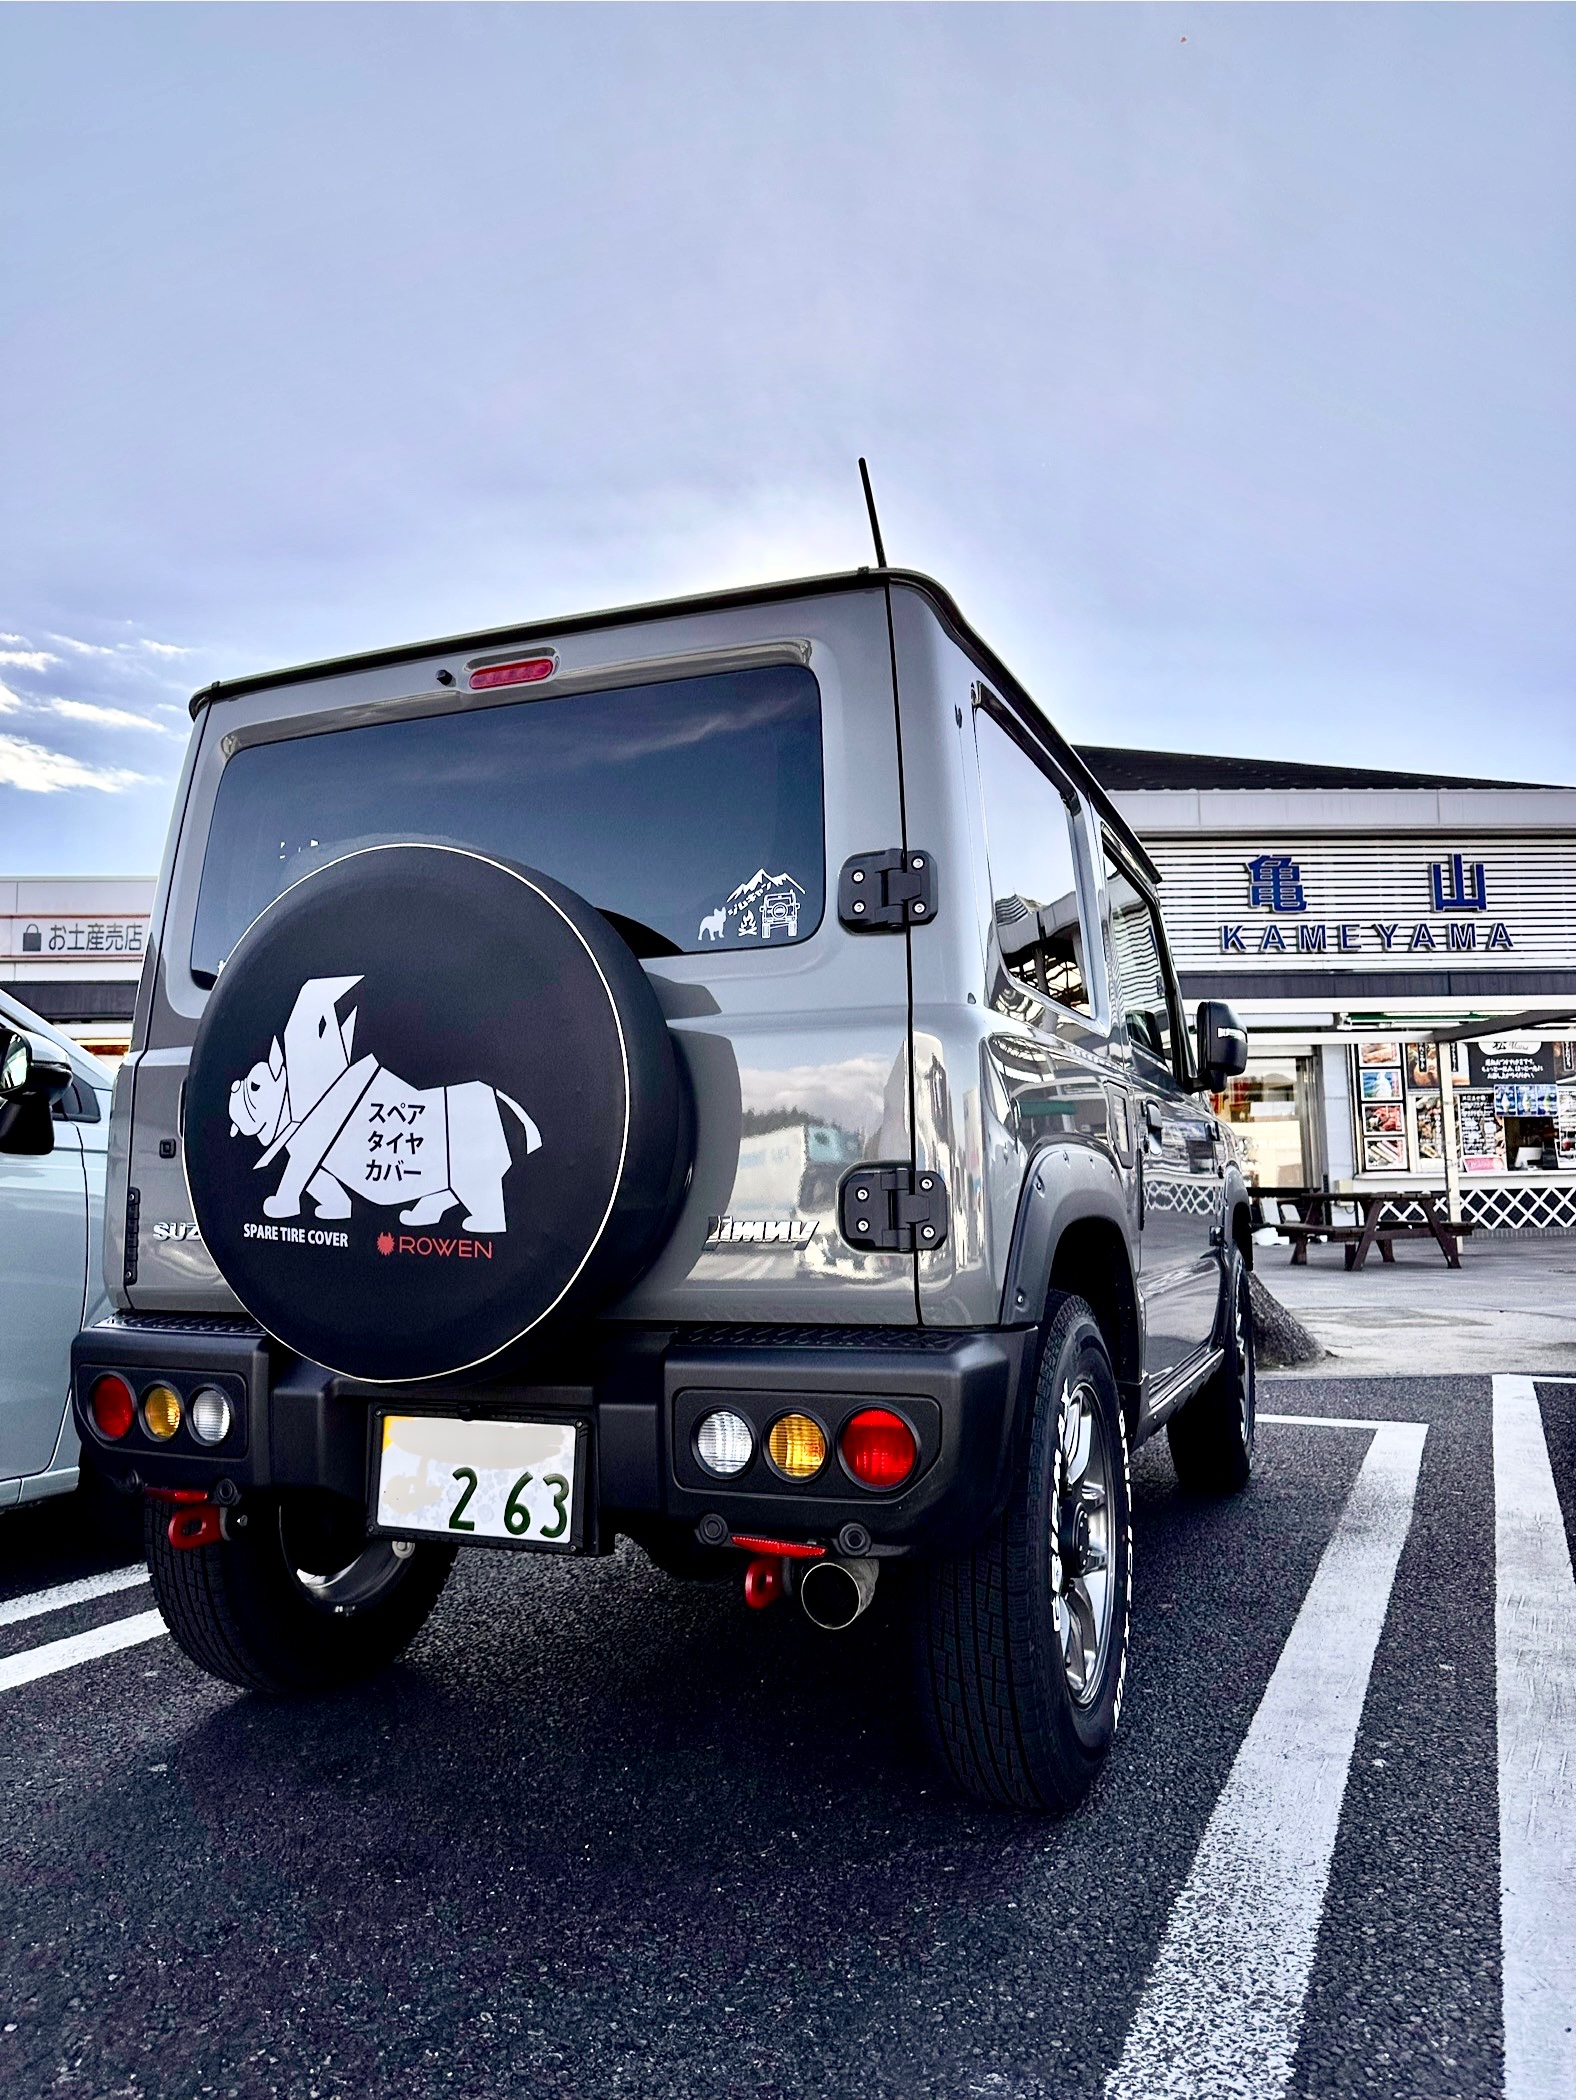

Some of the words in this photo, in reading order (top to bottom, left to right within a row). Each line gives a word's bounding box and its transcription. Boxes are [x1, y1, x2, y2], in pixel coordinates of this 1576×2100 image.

[1245, 854, 1487, 913] 亀山
[48, 923, 143, 951] お土産売店
[1221, 923, 1514, 952] KAMEYAMA
[368, 1102, 426, 1125] スペア
[367, 1131, 424, 1156] タイヤ
[365, 1159, 422, 1182] カバー
[243, 1223, 278, 1240] SPARE
[280, 1227, 305, 1243] TIRE
[308, 1230, 349, 1247] COVER
[398, 1237, 493, 1260] ROWEN
